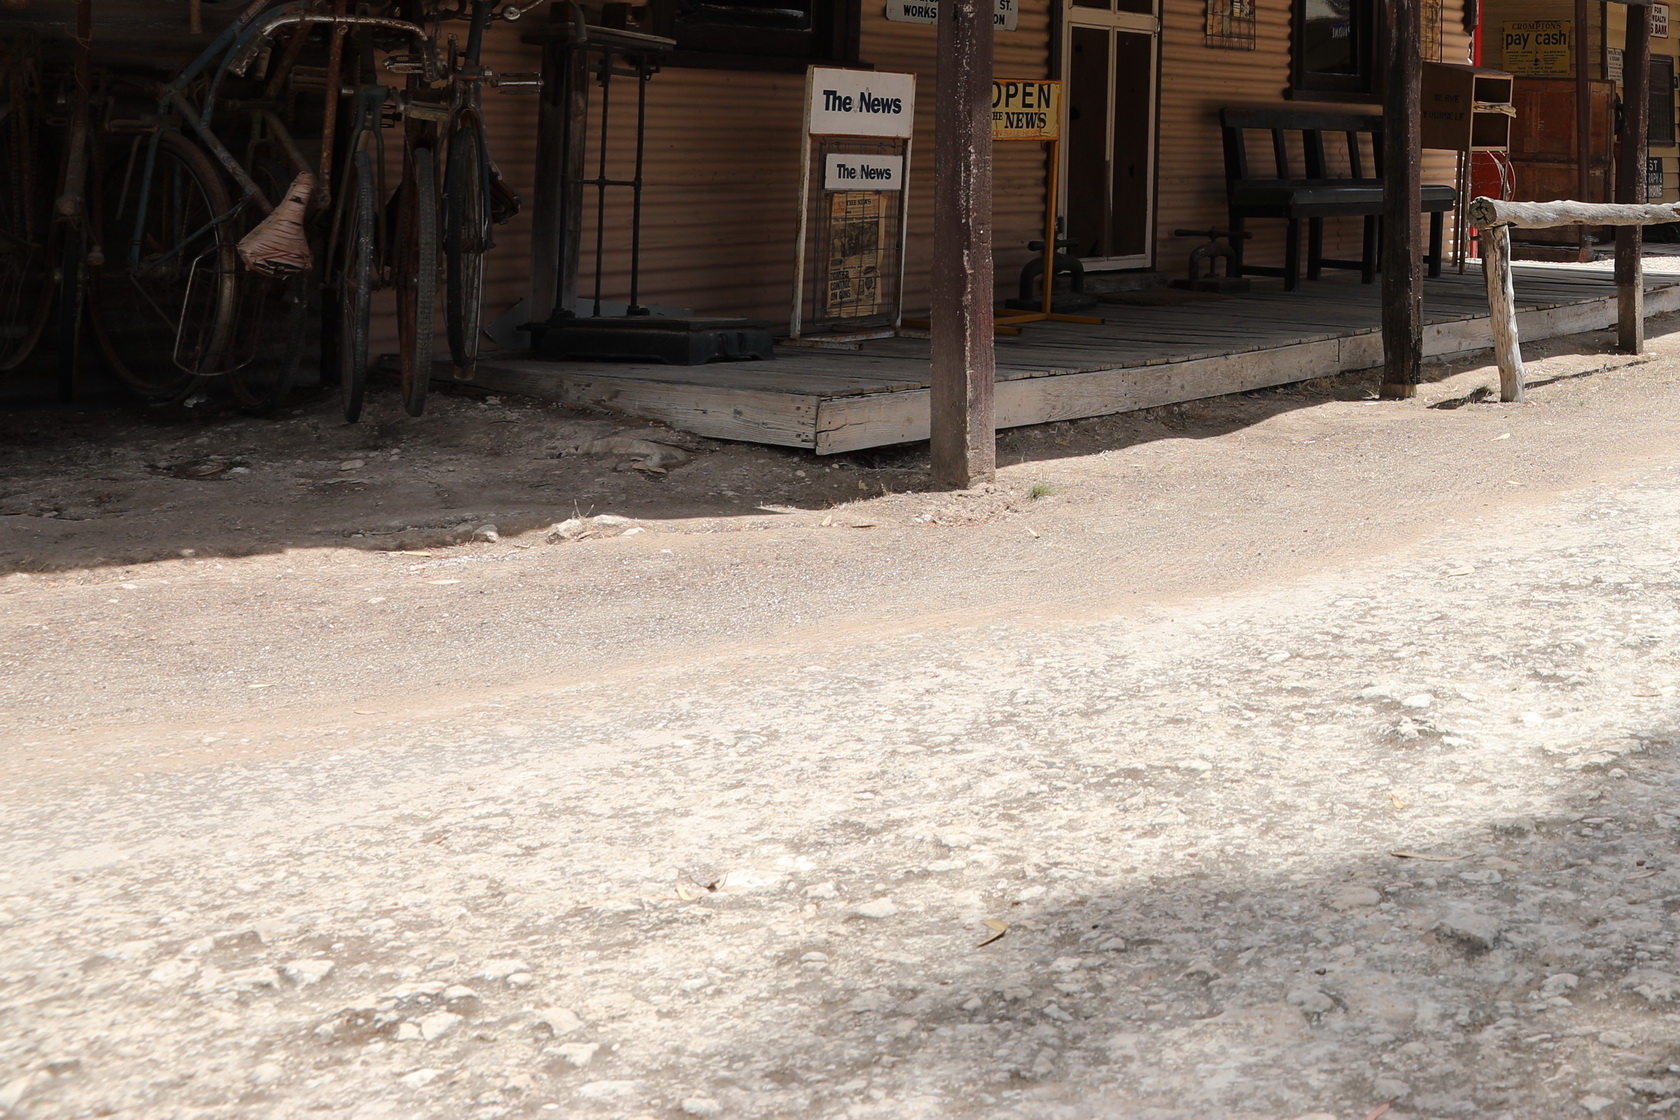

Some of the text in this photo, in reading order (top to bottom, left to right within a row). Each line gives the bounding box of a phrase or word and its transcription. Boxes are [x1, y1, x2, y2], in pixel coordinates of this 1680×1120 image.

[904, 4, 937, 19] WORKS
[999, 0, 1012, 11] ST.
[1655, 23, 1667, 35] BANK
[1505, 30, 1567, 50] pay cash
[823, 89, 902, 114] The News
[992, 81, 1051, 108] OPEN
[1433, 93, 1460, 103] SERVE
[992, 111, 1047, 129] HE NEWS
[836, 163, 891, 180] The News
